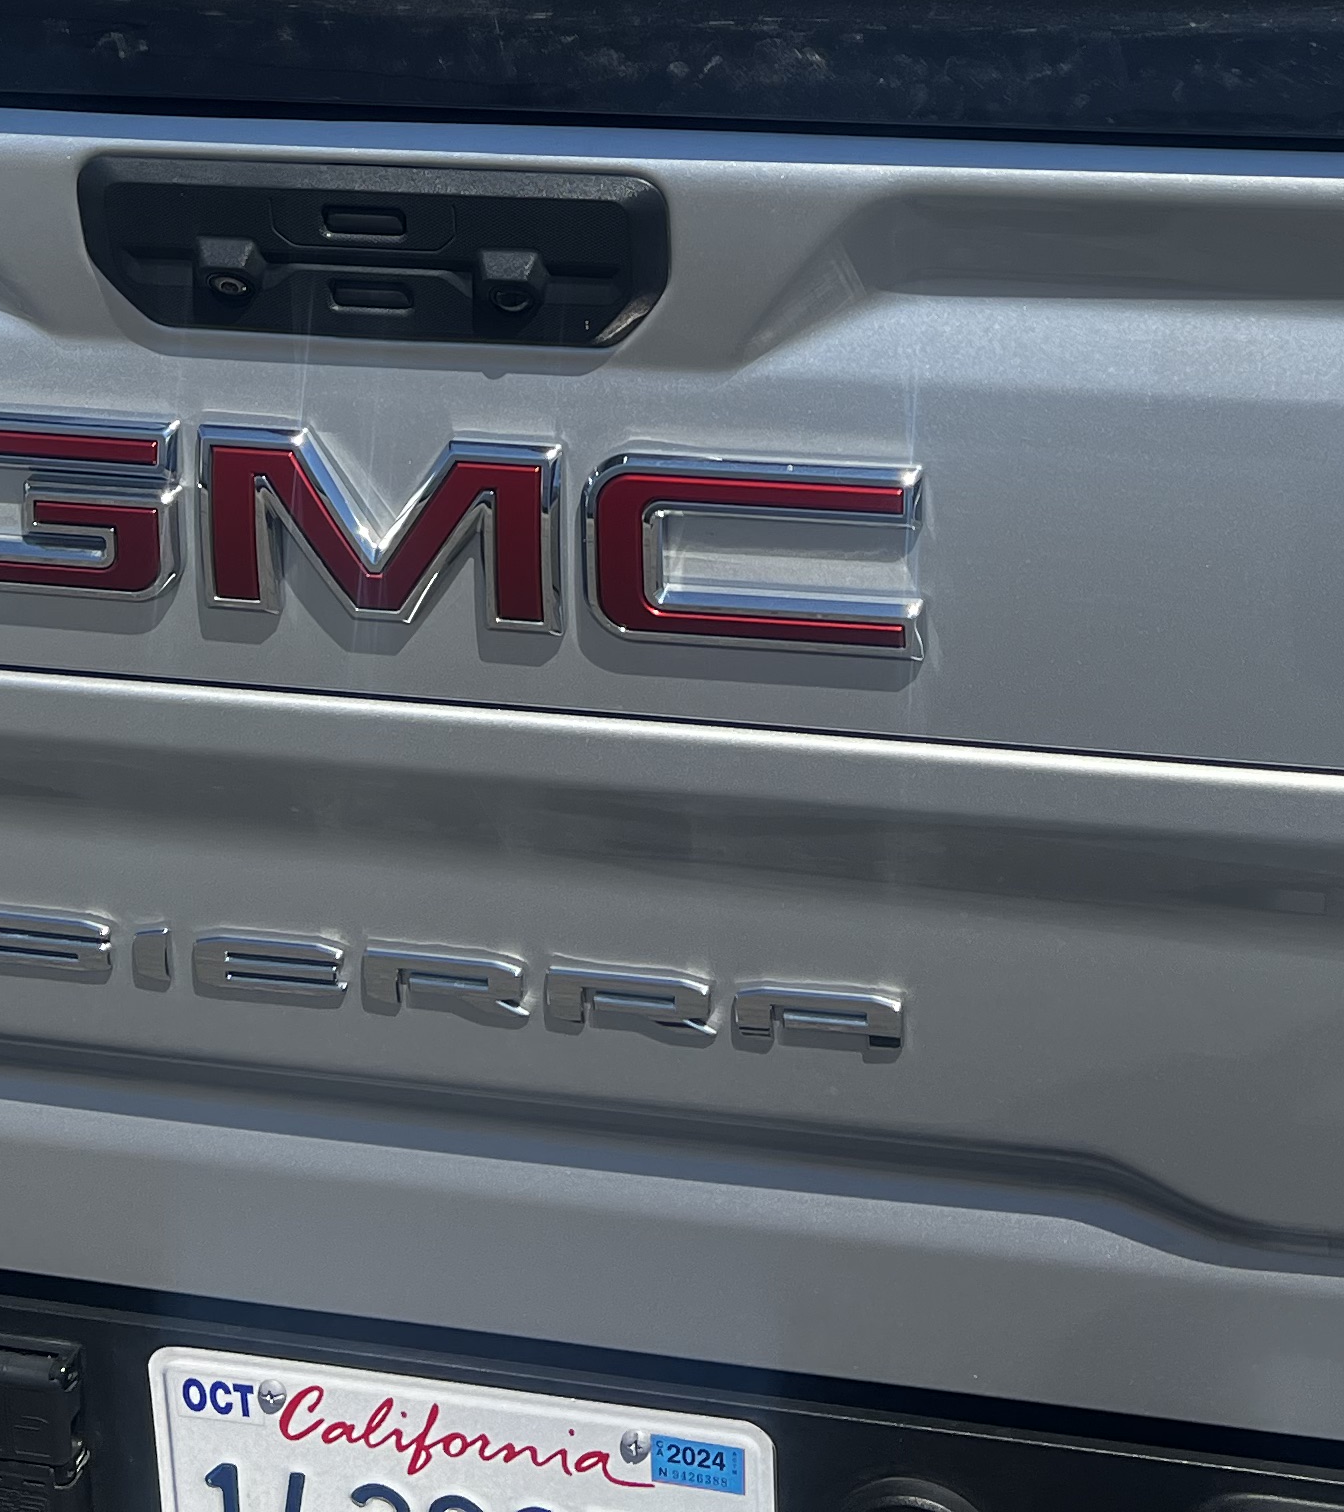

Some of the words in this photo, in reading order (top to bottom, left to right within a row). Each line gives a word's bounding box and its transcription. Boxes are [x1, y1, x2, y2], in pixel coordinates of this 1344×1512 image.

[182, 1377, 254, 1418] OCT
[278, 1384, 656, 1487] California
[667, 1443, 726, 1471] 2024
